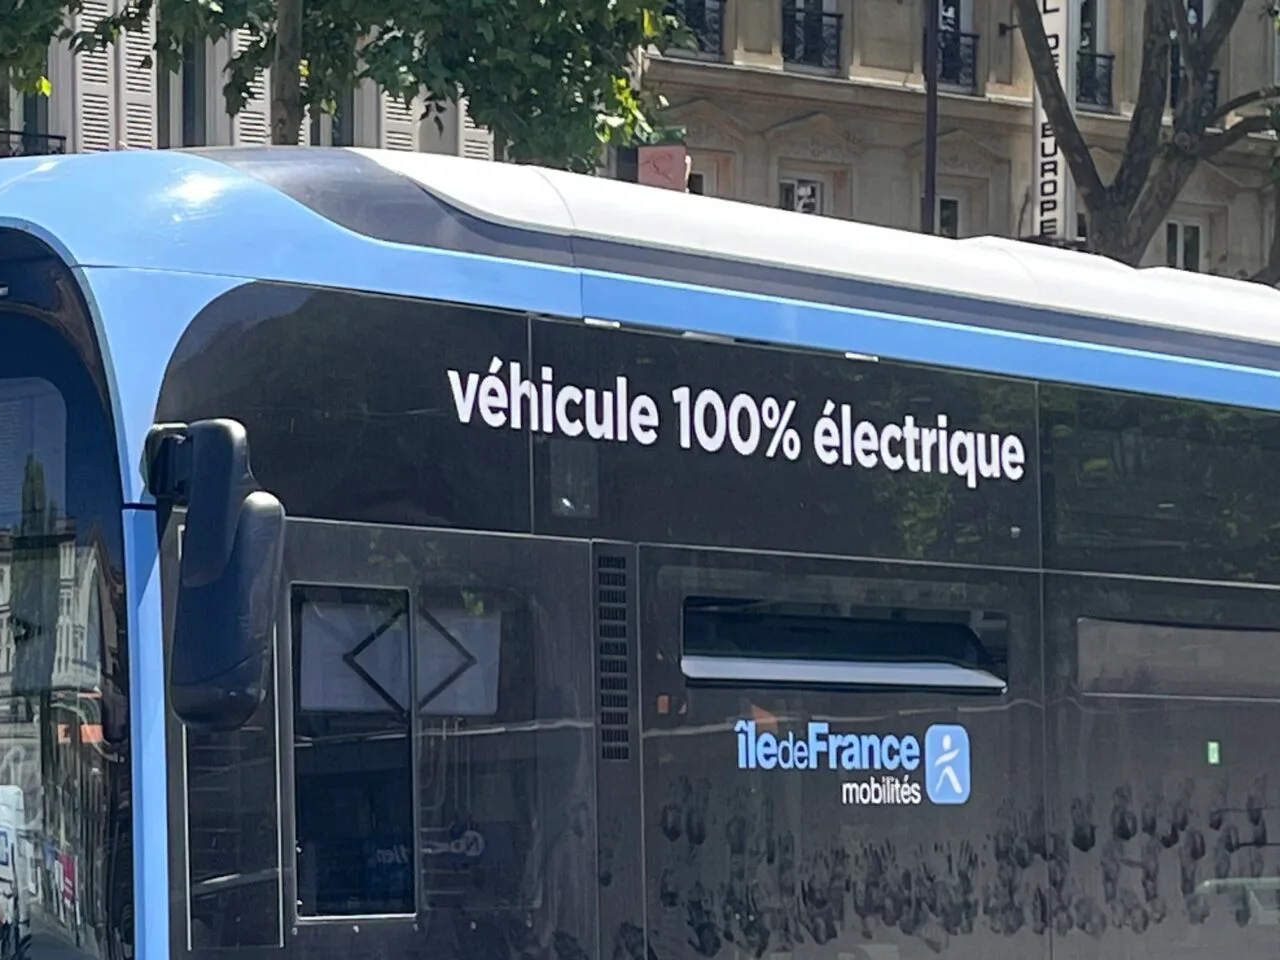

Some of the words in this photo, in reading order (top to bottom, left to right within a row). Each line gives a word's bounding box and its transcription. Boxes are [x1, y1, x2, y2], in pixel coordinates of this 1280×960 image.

[1040, 122, 1058, 236] EUROPE
[447, 356, 659, 445] véhicule
[672, 386, 802, 461] 100%
[813, 400, 1026, 488] électrique
[842, 774, 922, 804] mobilités
